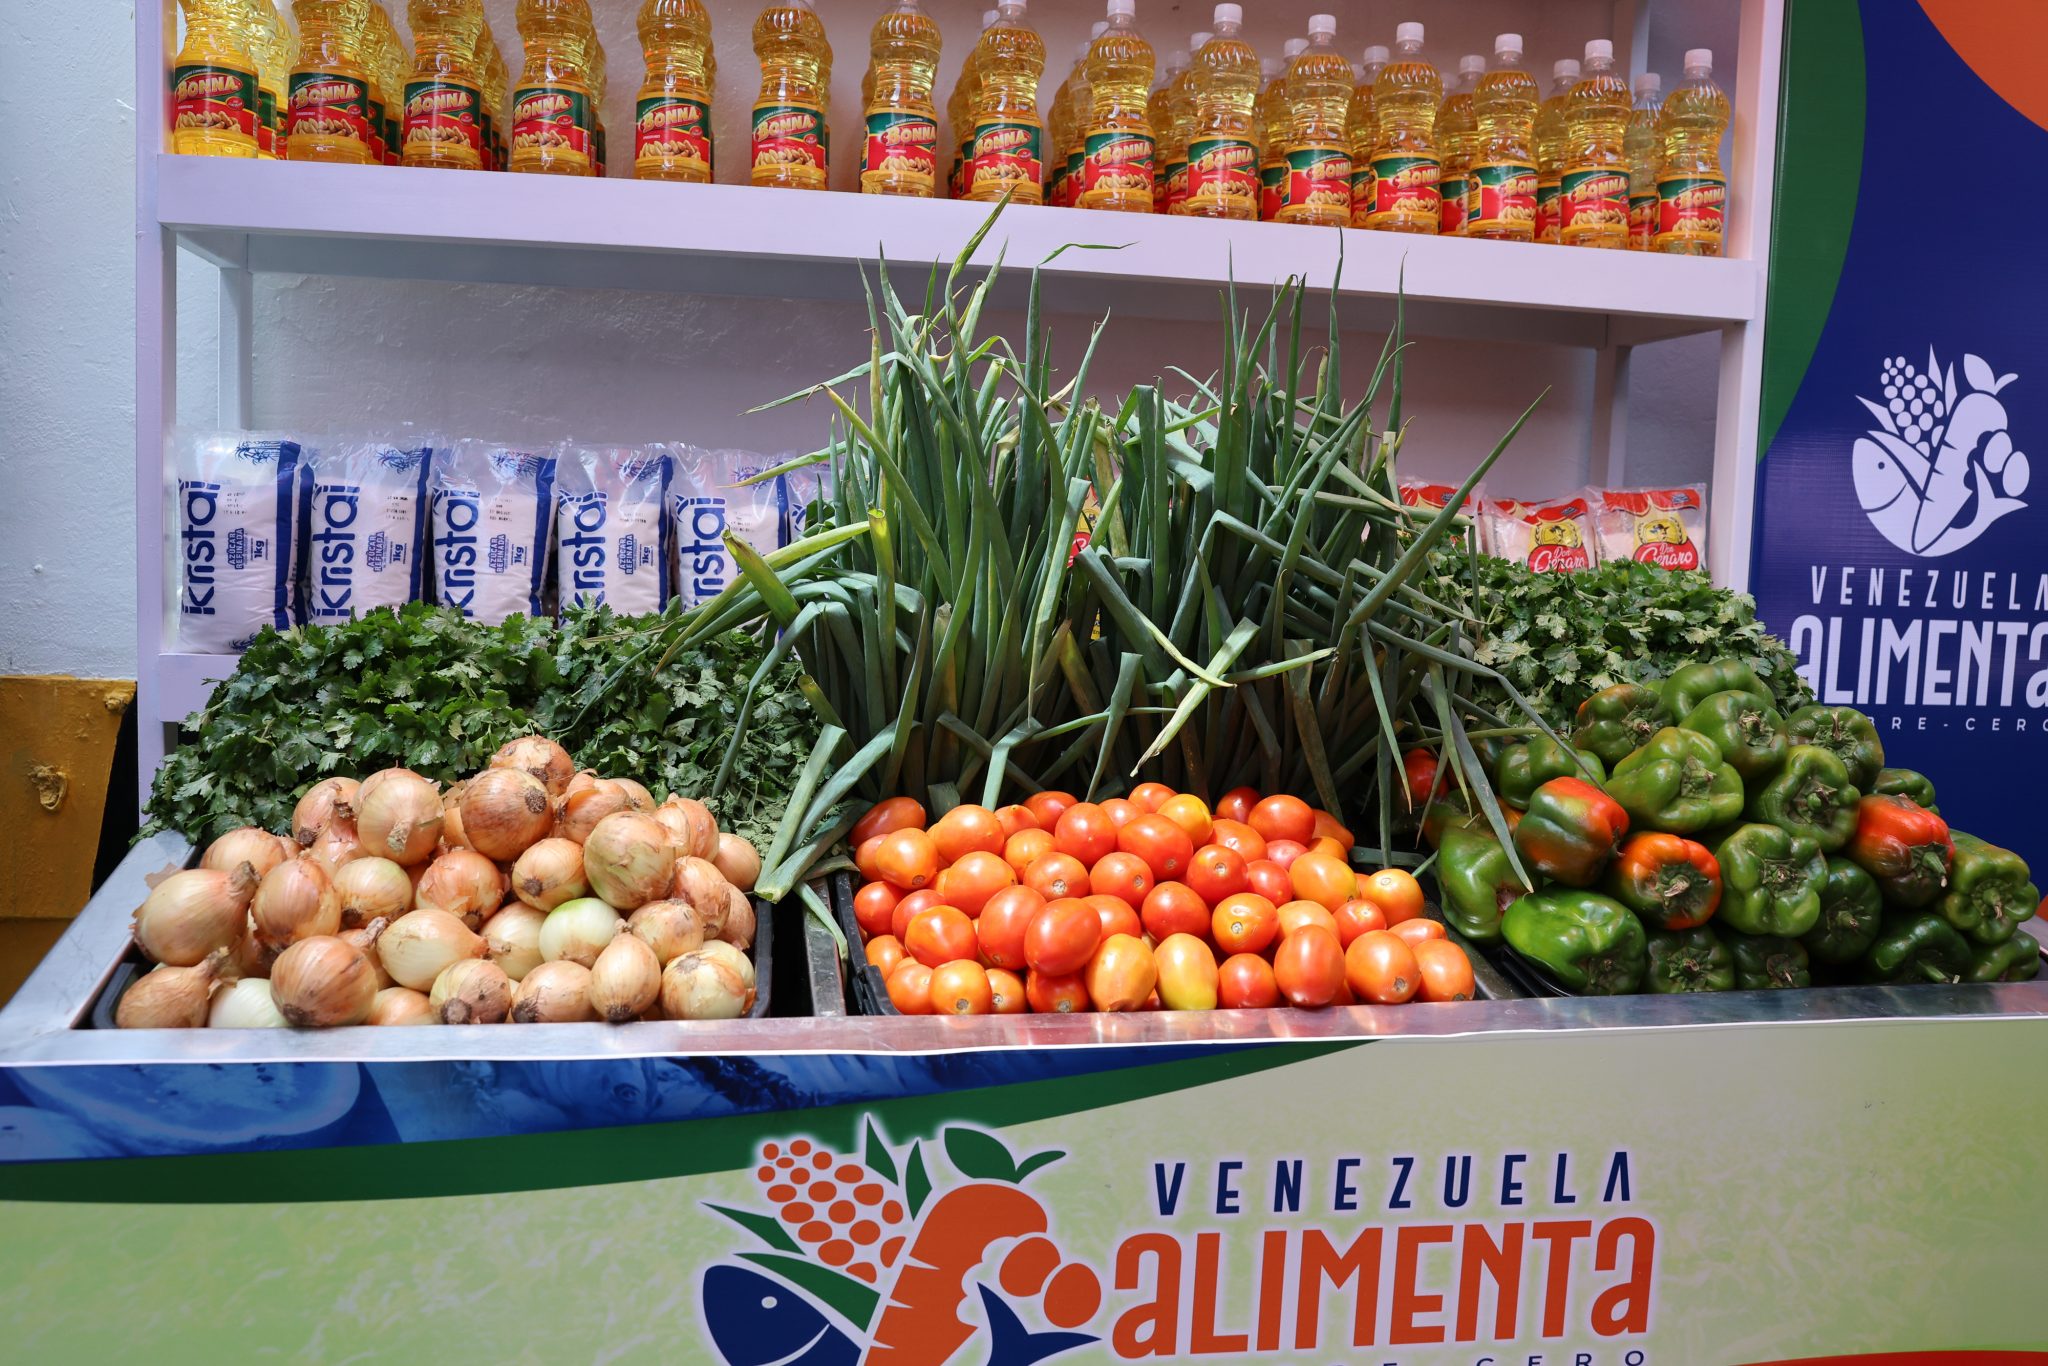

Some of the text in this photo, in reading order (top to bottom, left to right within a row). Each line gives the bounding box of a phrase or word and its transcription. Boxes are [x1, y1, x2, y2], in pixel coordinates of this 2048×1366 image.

[177, 76, 239, 103] BONNA
[295, 84, 359, 109] BONNA
[410, 92, 470, 117] BONNA
[514, 96, 569, 125] BONNA
[642, 106, 700, 133] BONNA
[757, 114, 815, 142] BONNA
[885, 126, 936, 147] BONNA
[975, 130, 1028, 159] BONNA
[1098, 141, 1153, 166] BONNA
[1200, 148, 1254, 173] BONNA
[1575, 177, 1627, 203] BONNA
[254, 540, 265, 558] 1kg
[393, 544, 403, 562] 1kg
[514, 546, 524, 563] 1kg
[642, 546, 651, 564] 1kg
[676, 494, 727, 607] ristal
[1811, 565, 2048, 611] VENEZUELA
[1154, 1151, 1632, 1216] VENEZUELA
